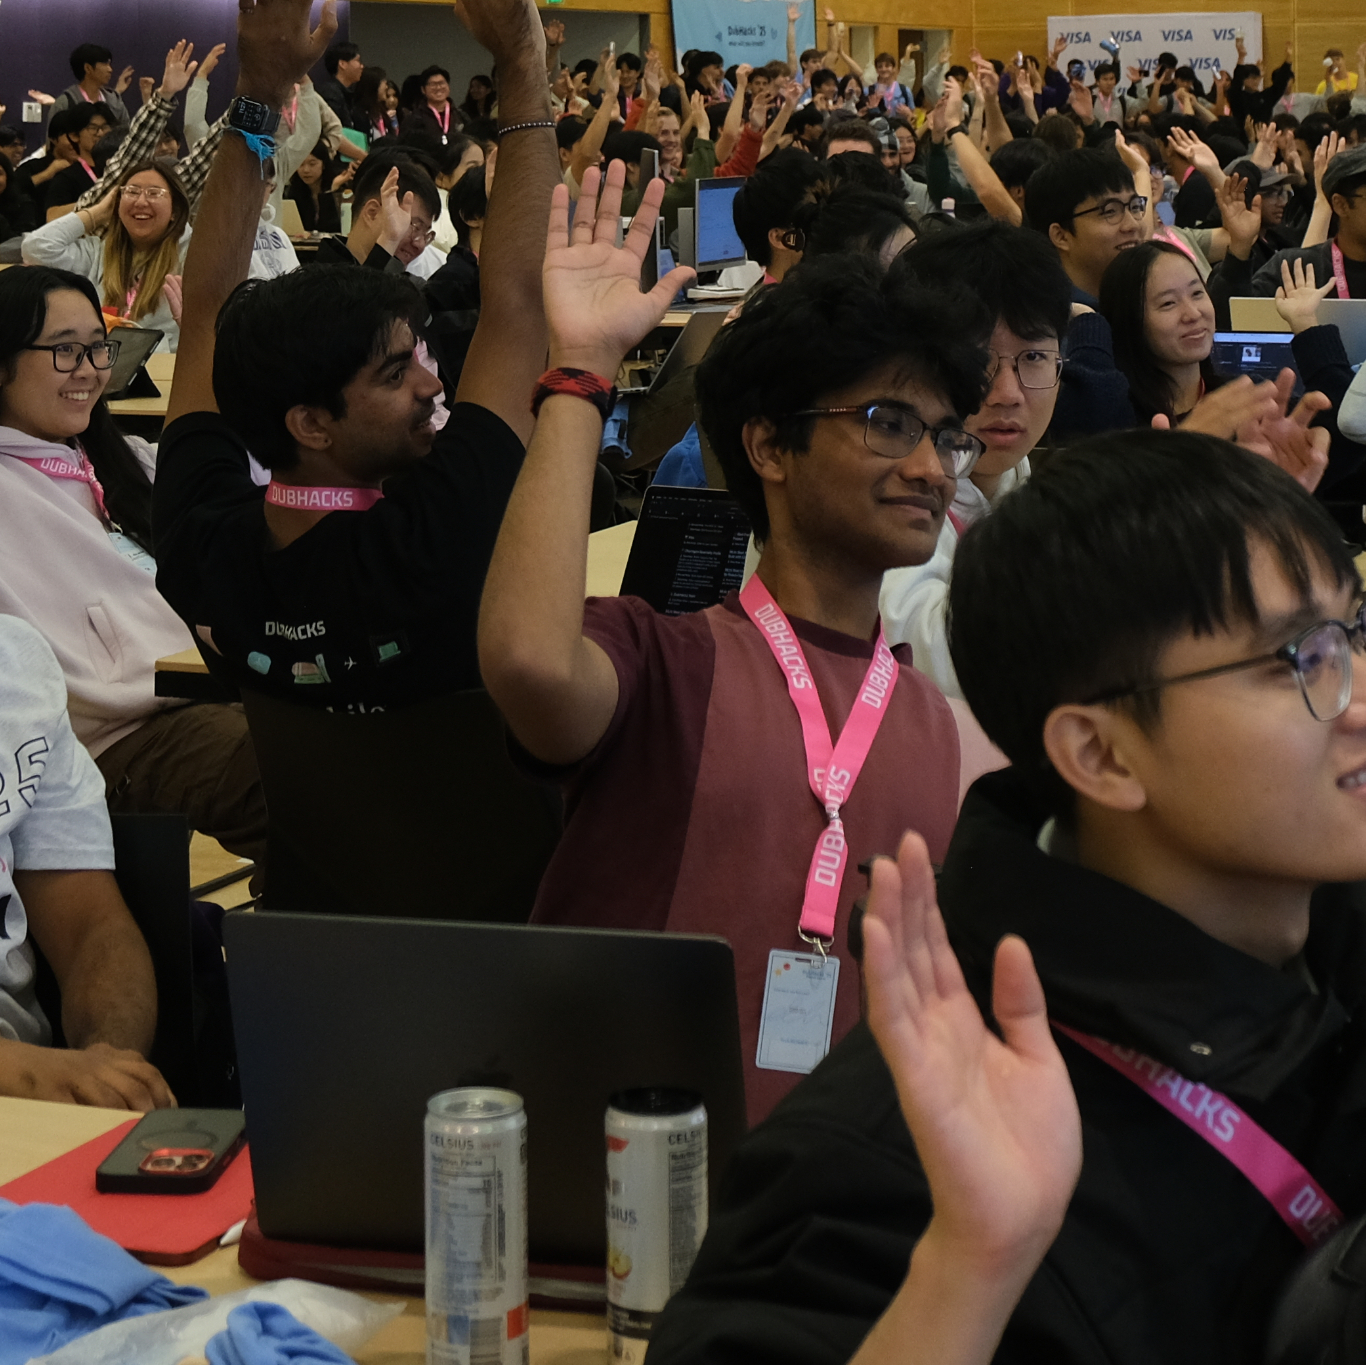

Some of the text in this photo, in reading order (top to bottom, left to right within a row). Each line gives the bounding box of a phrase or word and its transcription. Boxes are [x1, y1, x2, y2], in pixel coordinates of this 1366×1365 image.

[1162, 29, 1193, 41] VISA
[1213, 28, 1236, 41] VIS
[1138, 59, 1159, 71] VIS
[272, 485, 354, 508] DUBHACKS
[754, 602, 812, 690] DUBHACKS
[431, 1132, 474, 1150] CELSIUS
